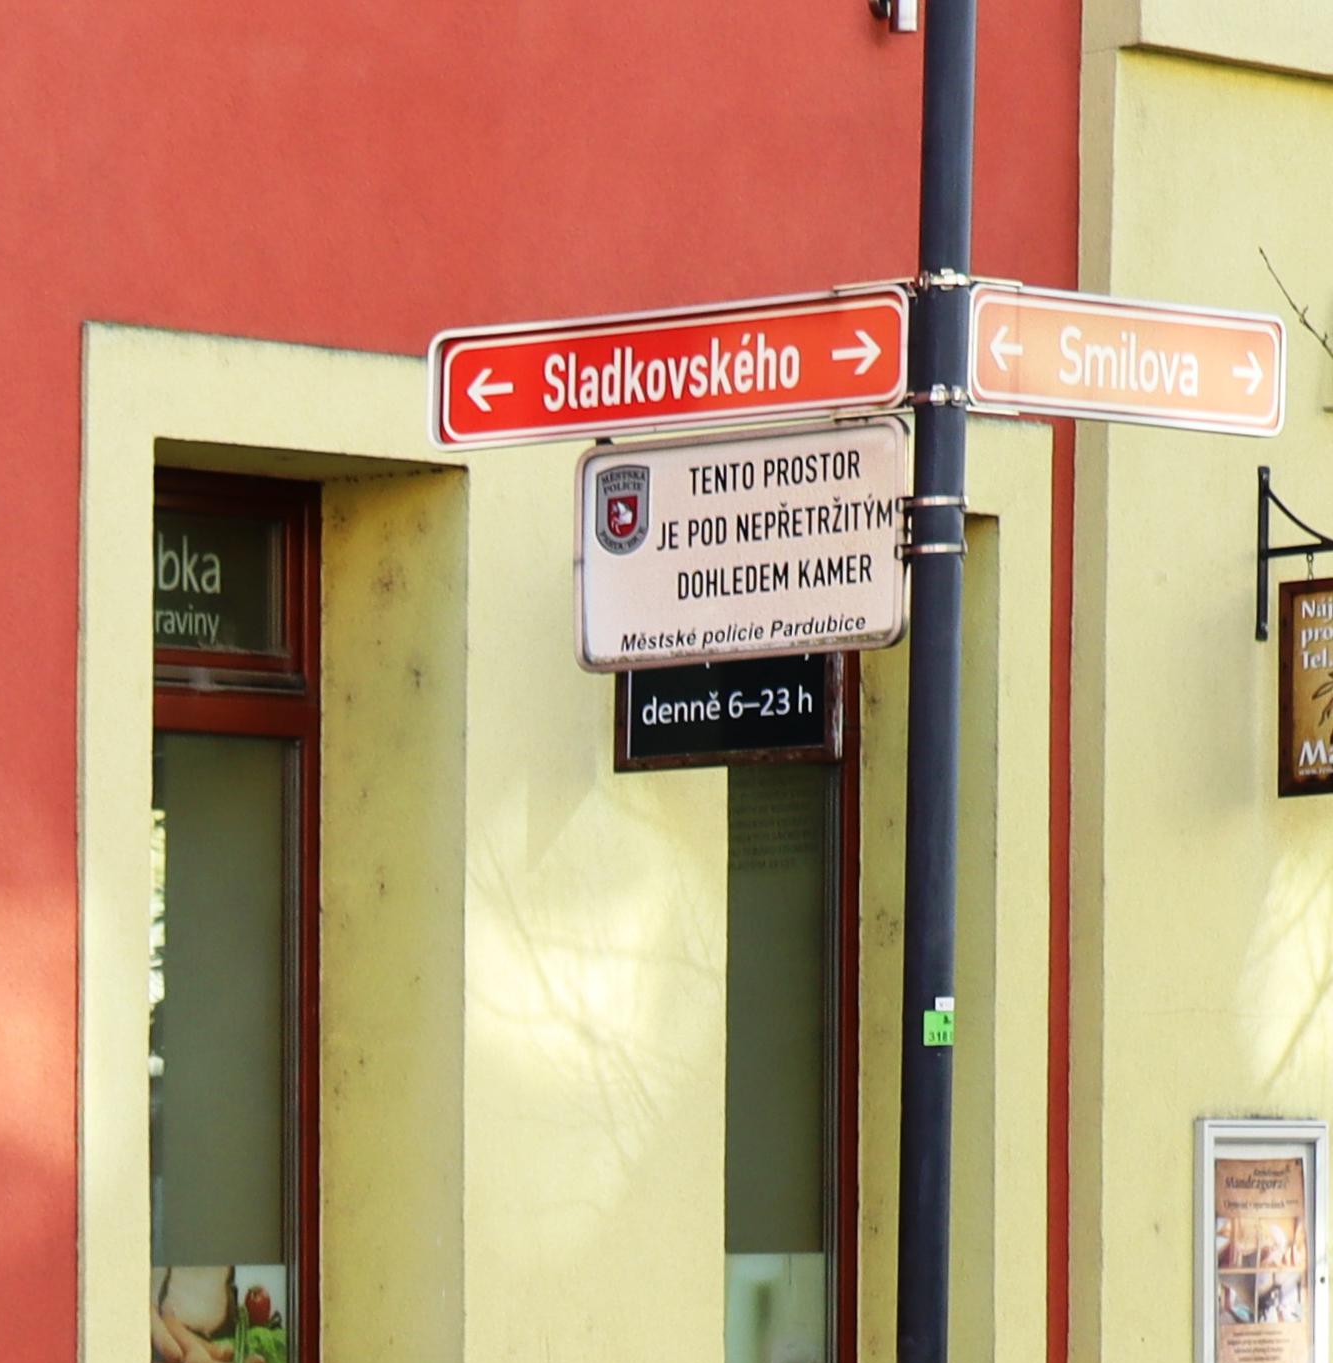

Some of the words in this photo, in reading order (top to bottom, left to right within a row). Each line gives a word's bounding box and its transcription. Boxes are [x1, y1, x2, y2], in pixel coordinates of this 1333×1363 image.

[543, 332, 801, 412] Sladkovského
[1059, 325, 1199, 396] Smilova
[689, 462, 753, 497] TENTO
[763, 450, 861, 489] PROSTOR
[657, 519, 679, 551] JE
[688, 514, 728, 547] POD
[736, 495, 894, 542] NEPŘETRŽITÝM
[677, 561, 789, 600] DOHLEDEM
[799, 553, 873, 588] KAMER
[621, 626, 697, 651] Městské
[702, 622, 764, 647] policie
[770, 613, 866, 638] Pardubice
[642, 691, 721, 726] denně
[797, 684, 813, 714] h
